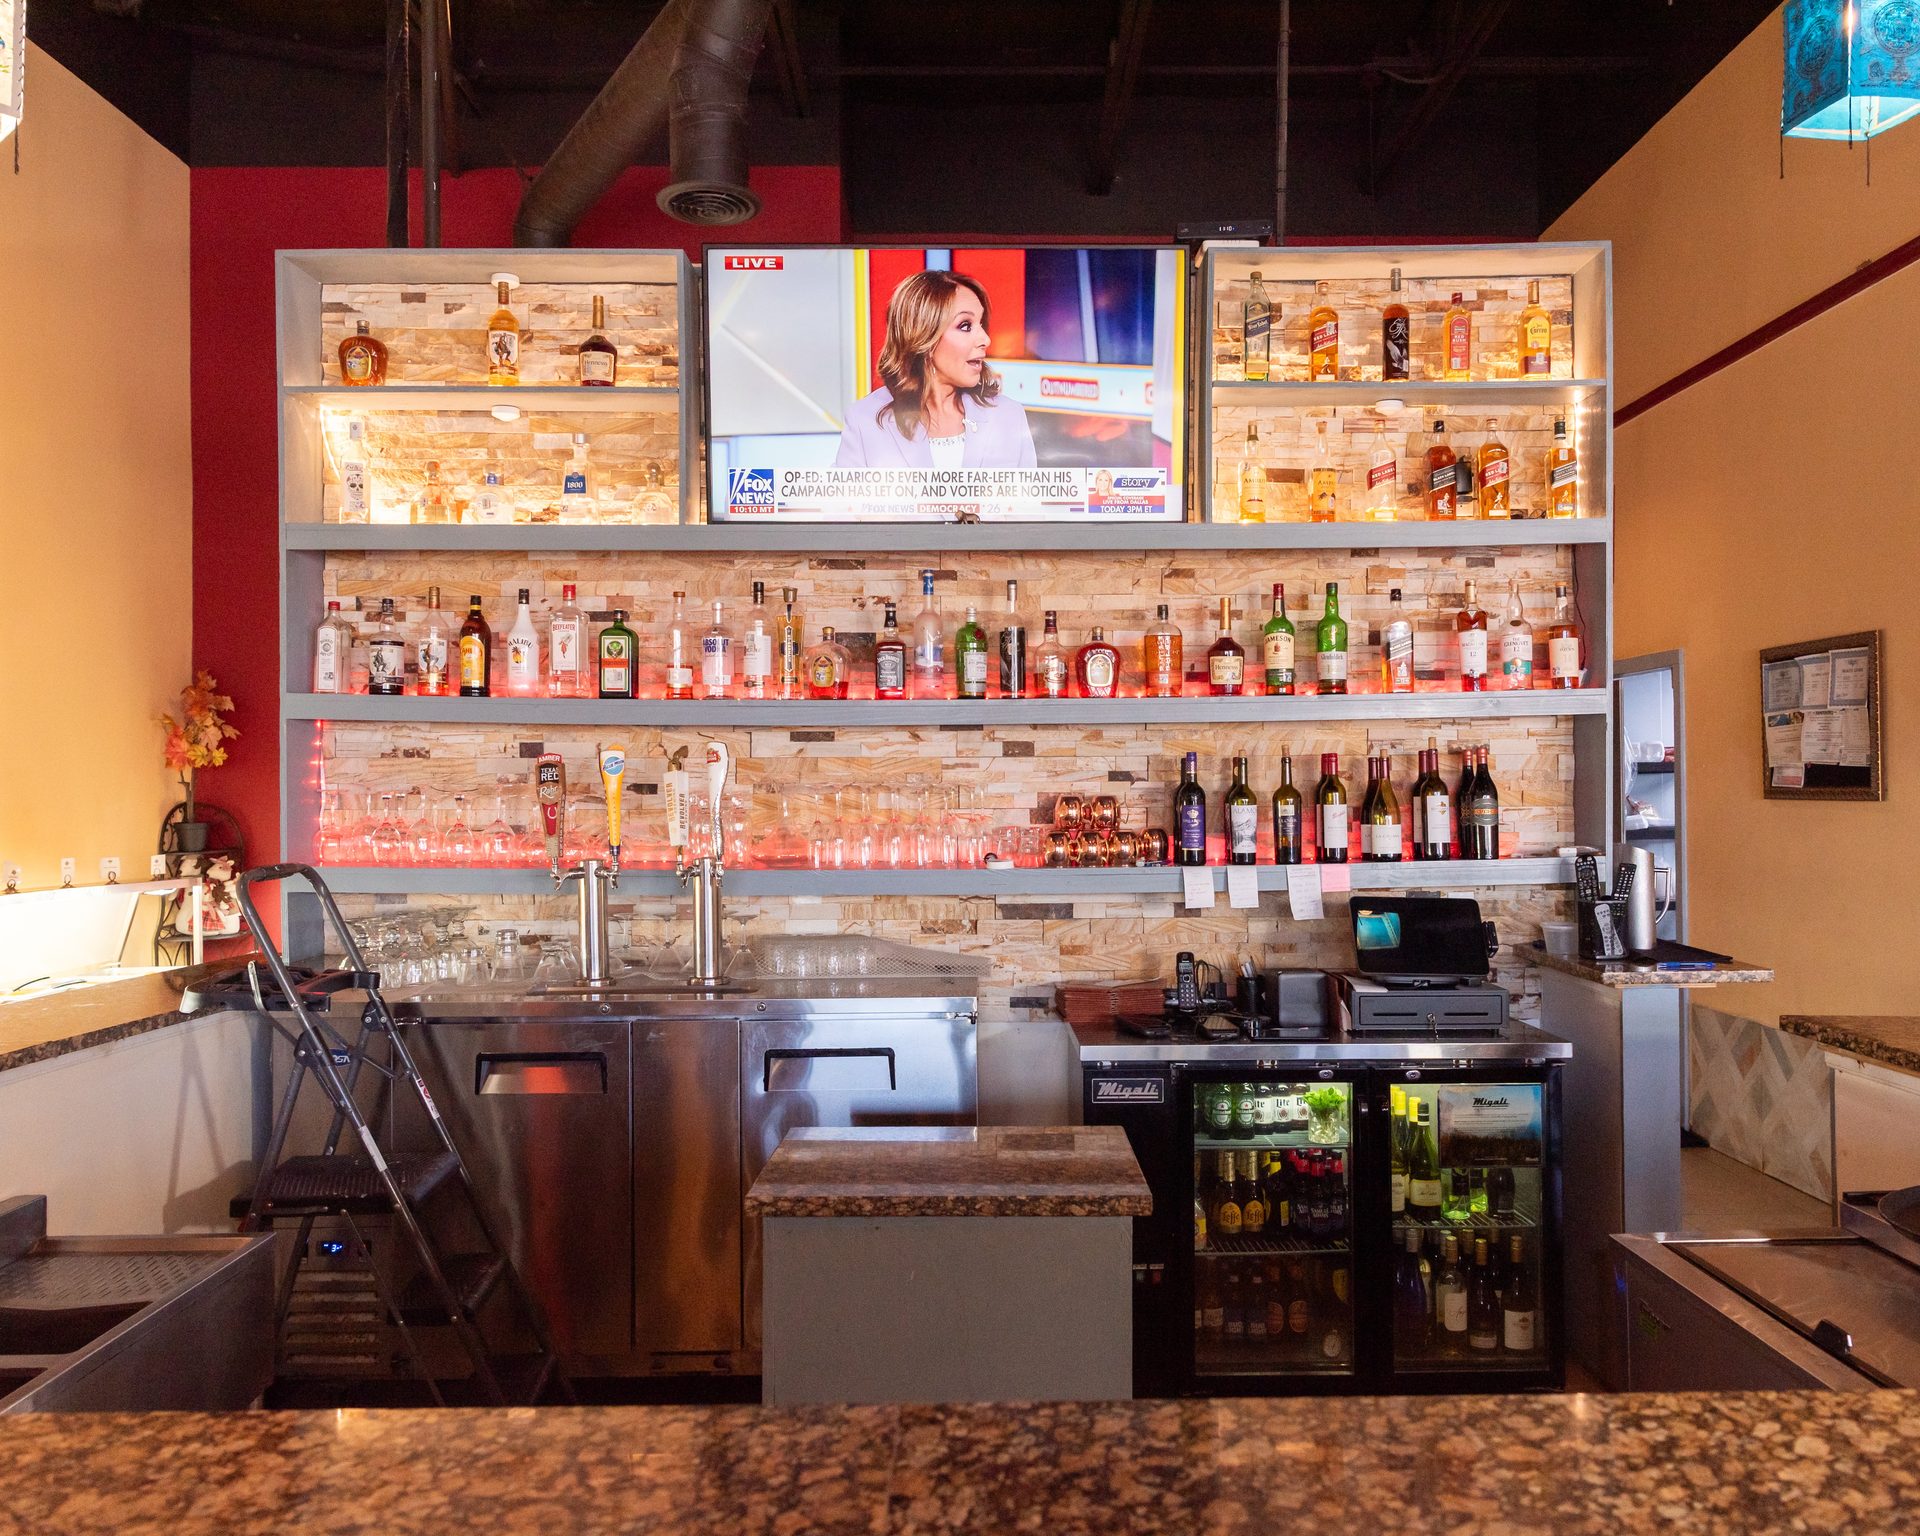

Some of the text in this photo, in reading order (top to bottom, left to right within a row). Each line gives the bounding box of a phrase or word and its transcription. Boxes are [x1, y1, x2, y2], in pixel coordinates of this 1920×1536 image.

[732, 257, 777, 268] LIVE
[784, 471, 1072, 483] OP-ED: TALARICO IS EVEN MORE FAR-LEFT THAN HIS
[567, 481, 583, 489] 1800
[744, 479, 772, 491] FOX
[1121, 478, 1151, 488] story
[781, 485, 1078, 499] CAMPAIGN HAS LET ON, AND VOTERS ARE NOTICING
[736, 491, 774, 504] NEWS
[868, 504, 885, 513] FOX
[887, 504, 915, 513] NEWS
[919, 504, 978, 513] DEMOCRACY
[1101, 505, 1152, 513] TODAY 3PM ET
[1266, 635, 1291, 643] JAMESON
[704, 645, 727, 653] VODA
[539, 755, 560, 763] AMBER
[1098, 1082, 1159, 1098] Migali
[1276, 1098, 1290, 1108] Lite
[1472, 1097, 1510, 1107] Migali
